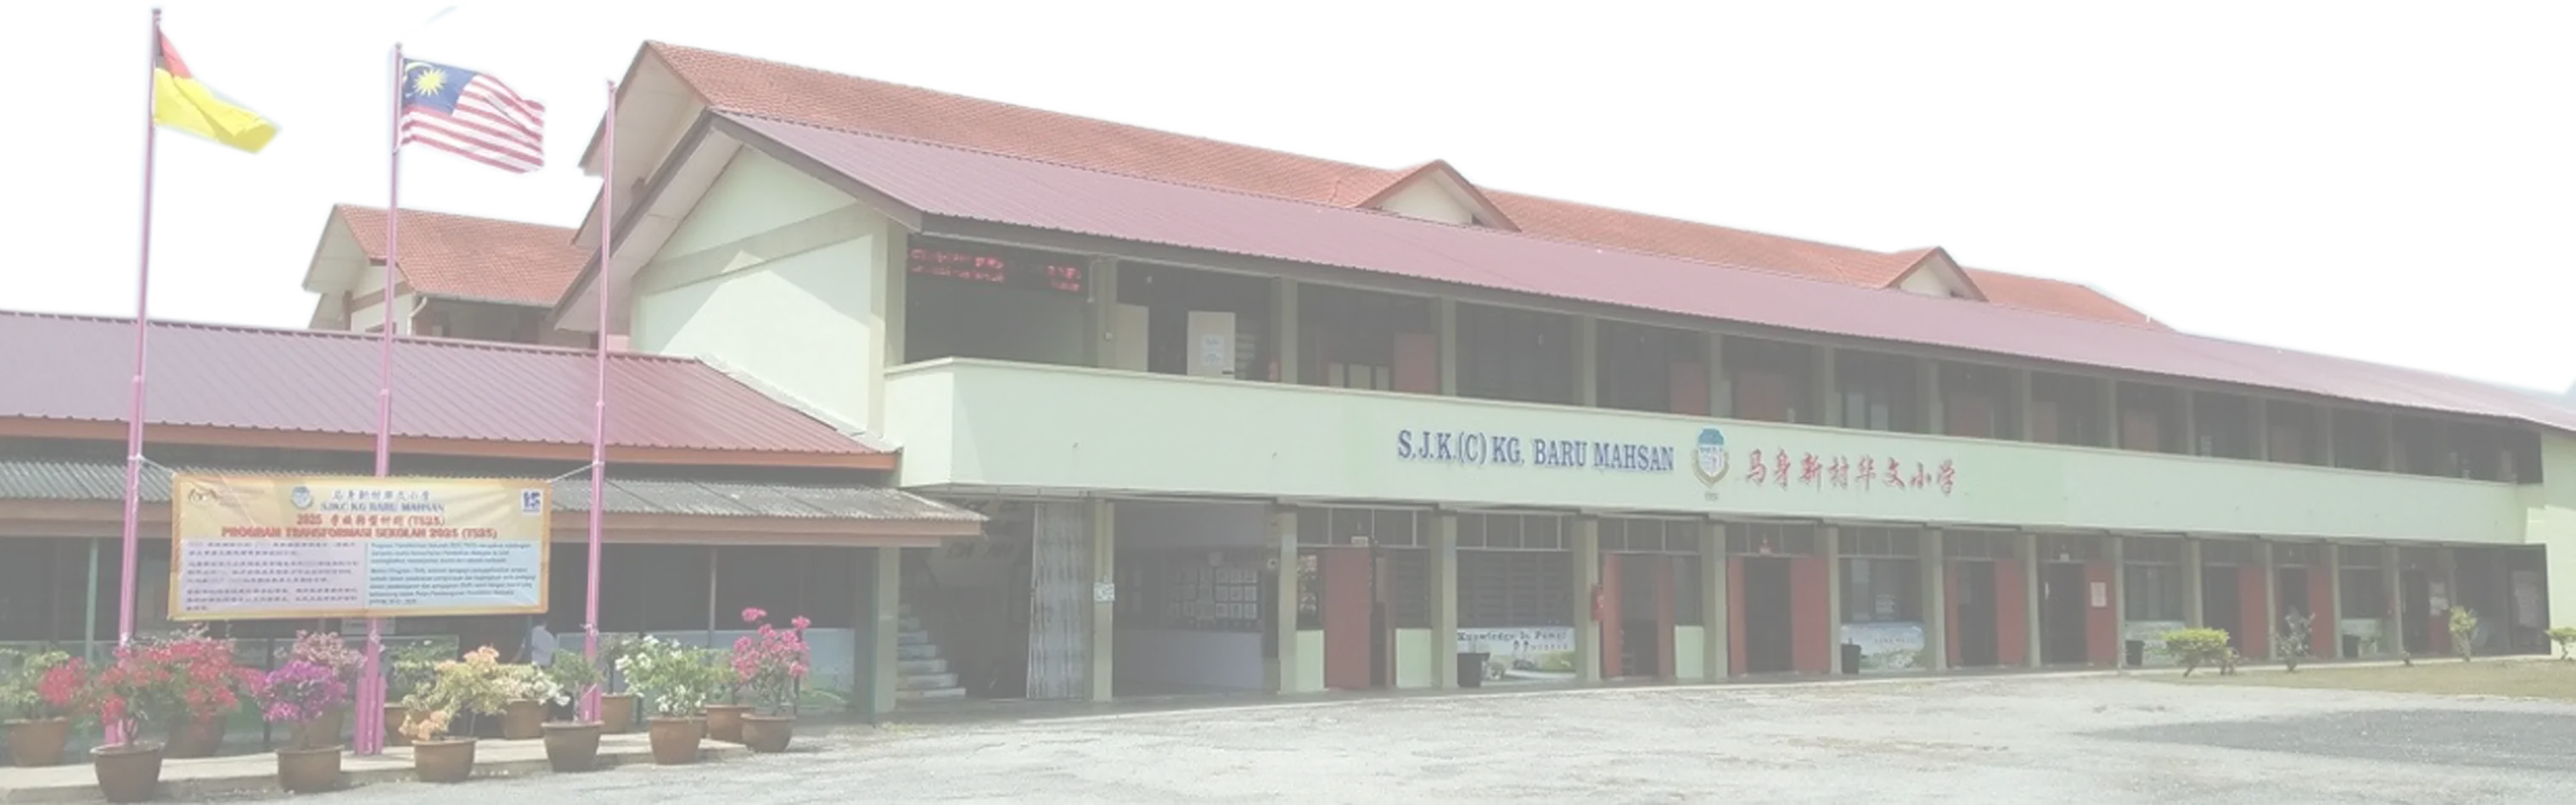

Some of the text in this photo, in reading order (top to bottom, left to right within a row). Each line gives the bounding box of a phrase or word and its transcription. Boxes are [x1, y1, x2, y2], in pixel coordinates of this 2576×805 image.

[1398, 429, 1675, 471] S.J.K.(C) KG. BARU MAHSAN
[1745, 446, 1956, 498] 马身新村华文小学
[222, 526, 282, 538] PROGRAM
[285, 527, 372, 538] TRANSFORMASI
[375, 527, 426, 538] SEKOLAH
[429, 527, 458, 538] 2025
